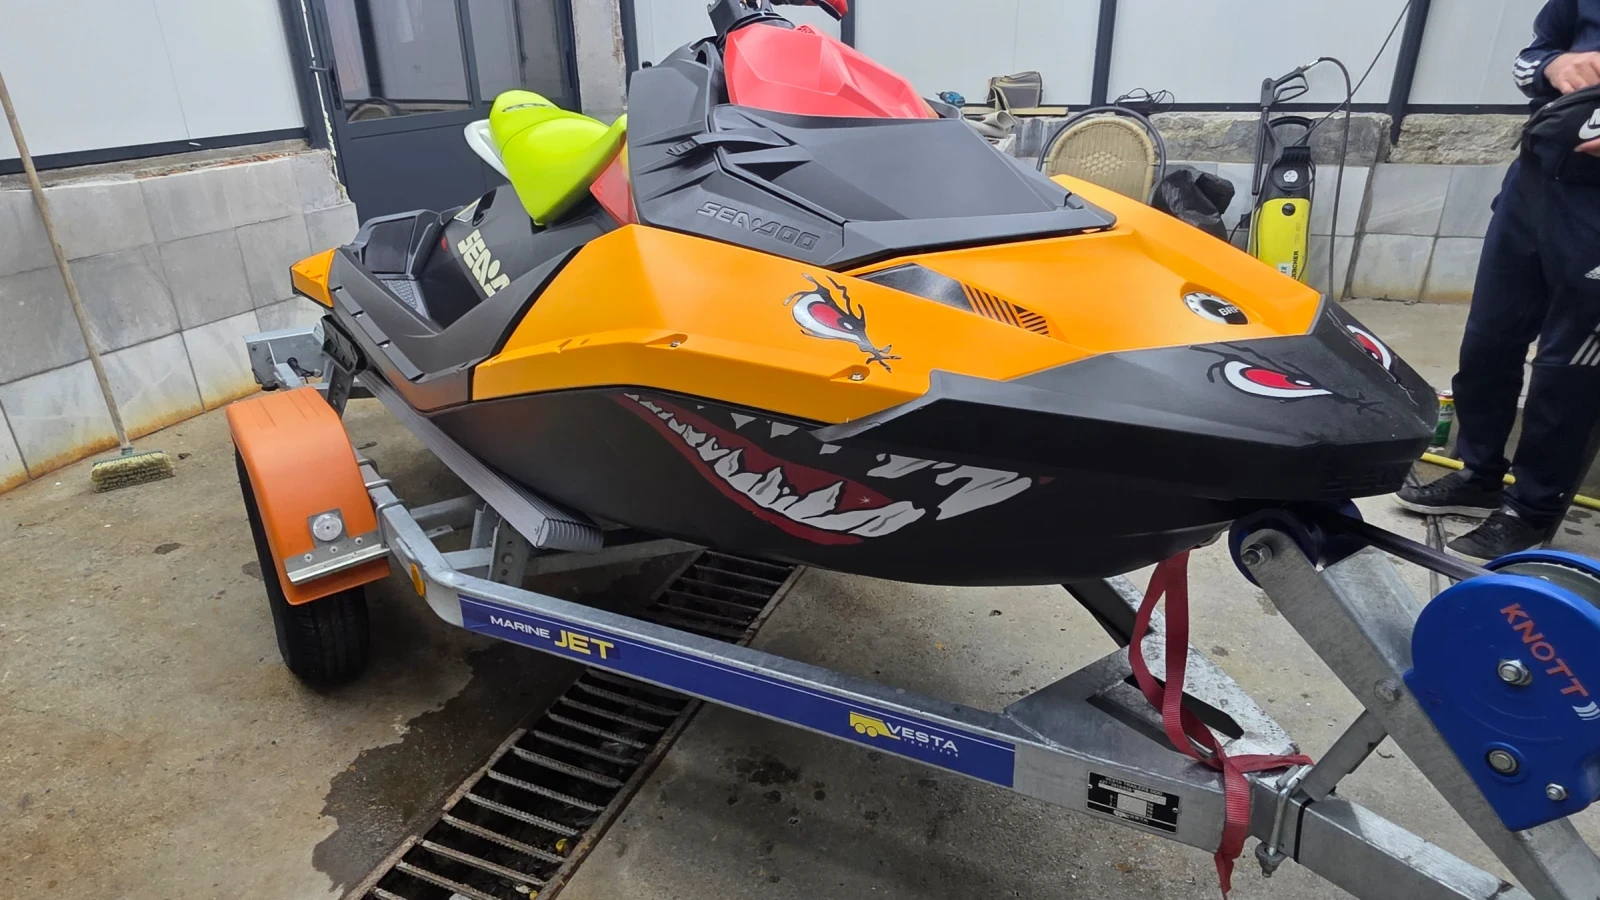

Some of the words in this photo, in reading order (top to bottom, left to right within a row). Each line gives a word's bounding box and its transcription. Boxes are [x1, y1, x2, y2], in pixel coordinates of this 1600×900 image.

[490, 615, 550, 639] MARINE
[554, 629, 615, 660] JET
[1500, 603, 1589, 697] KNOTT
[886, 722, 958, 752] VESTA
